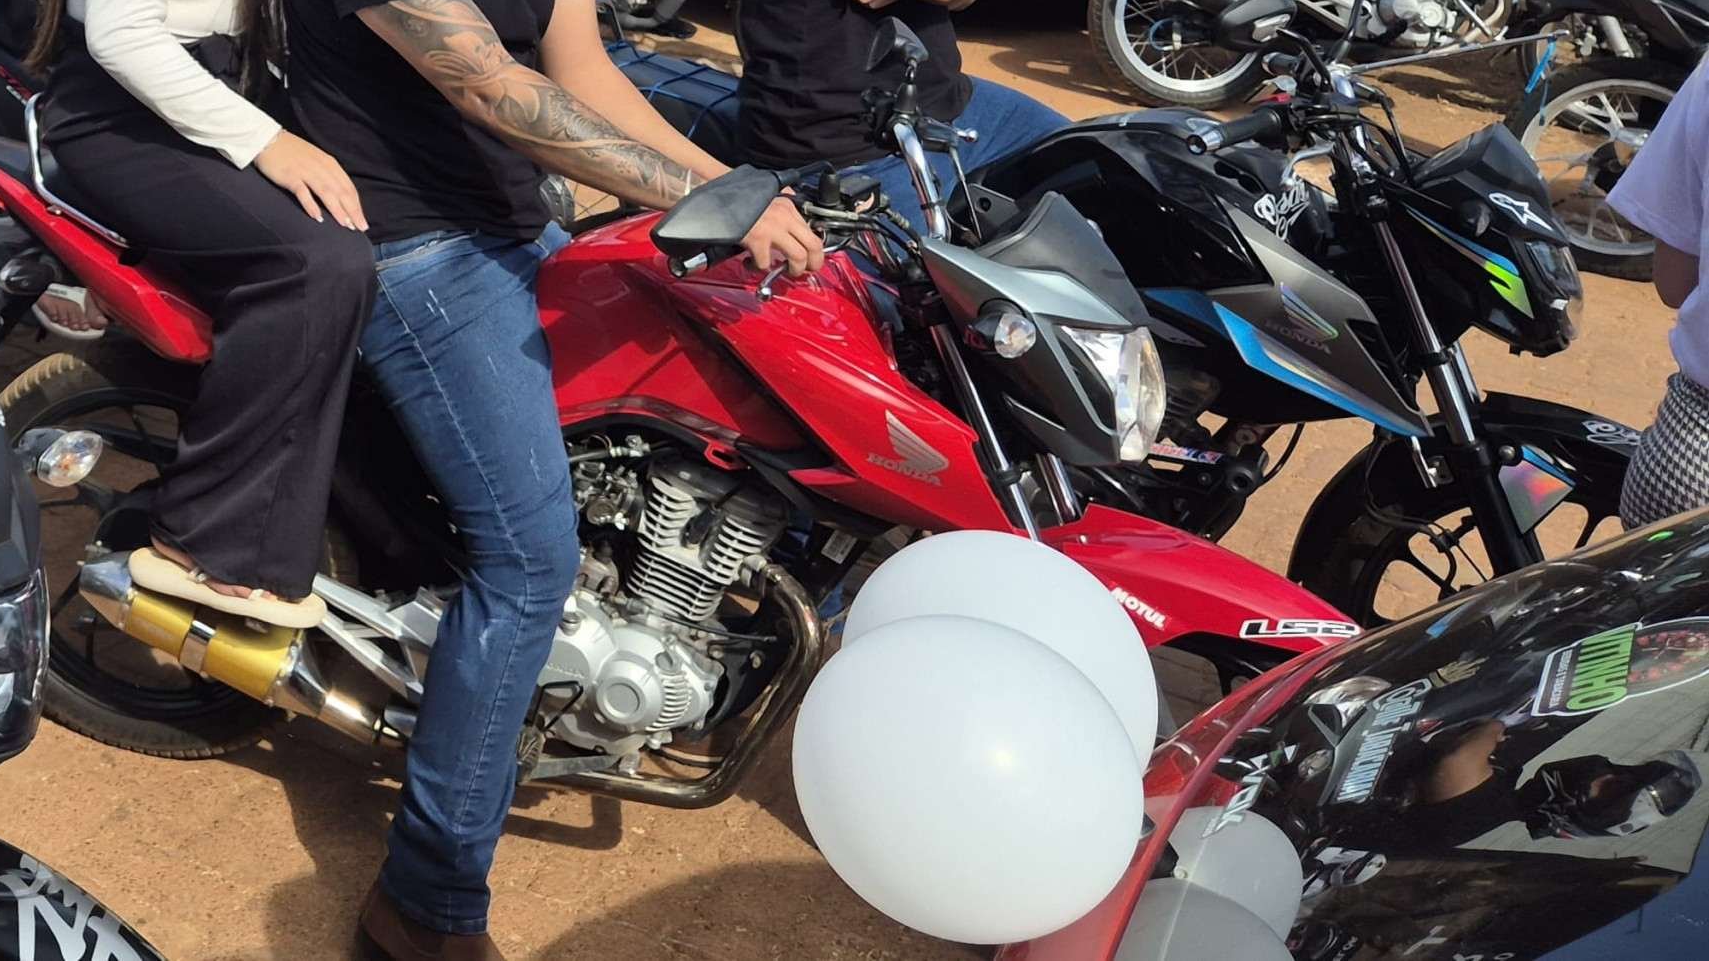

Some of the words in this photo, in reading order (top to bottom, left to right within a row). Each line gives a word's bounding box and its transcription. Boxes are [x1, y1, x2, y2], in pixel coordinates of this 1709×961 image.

[1263, 318, 1332, 355] HONDA
[865, 452, 942, 487] HONDA
[1110, 586, 1167, 631] MOTUL
[1239, 618, 1361, 639] LS2
